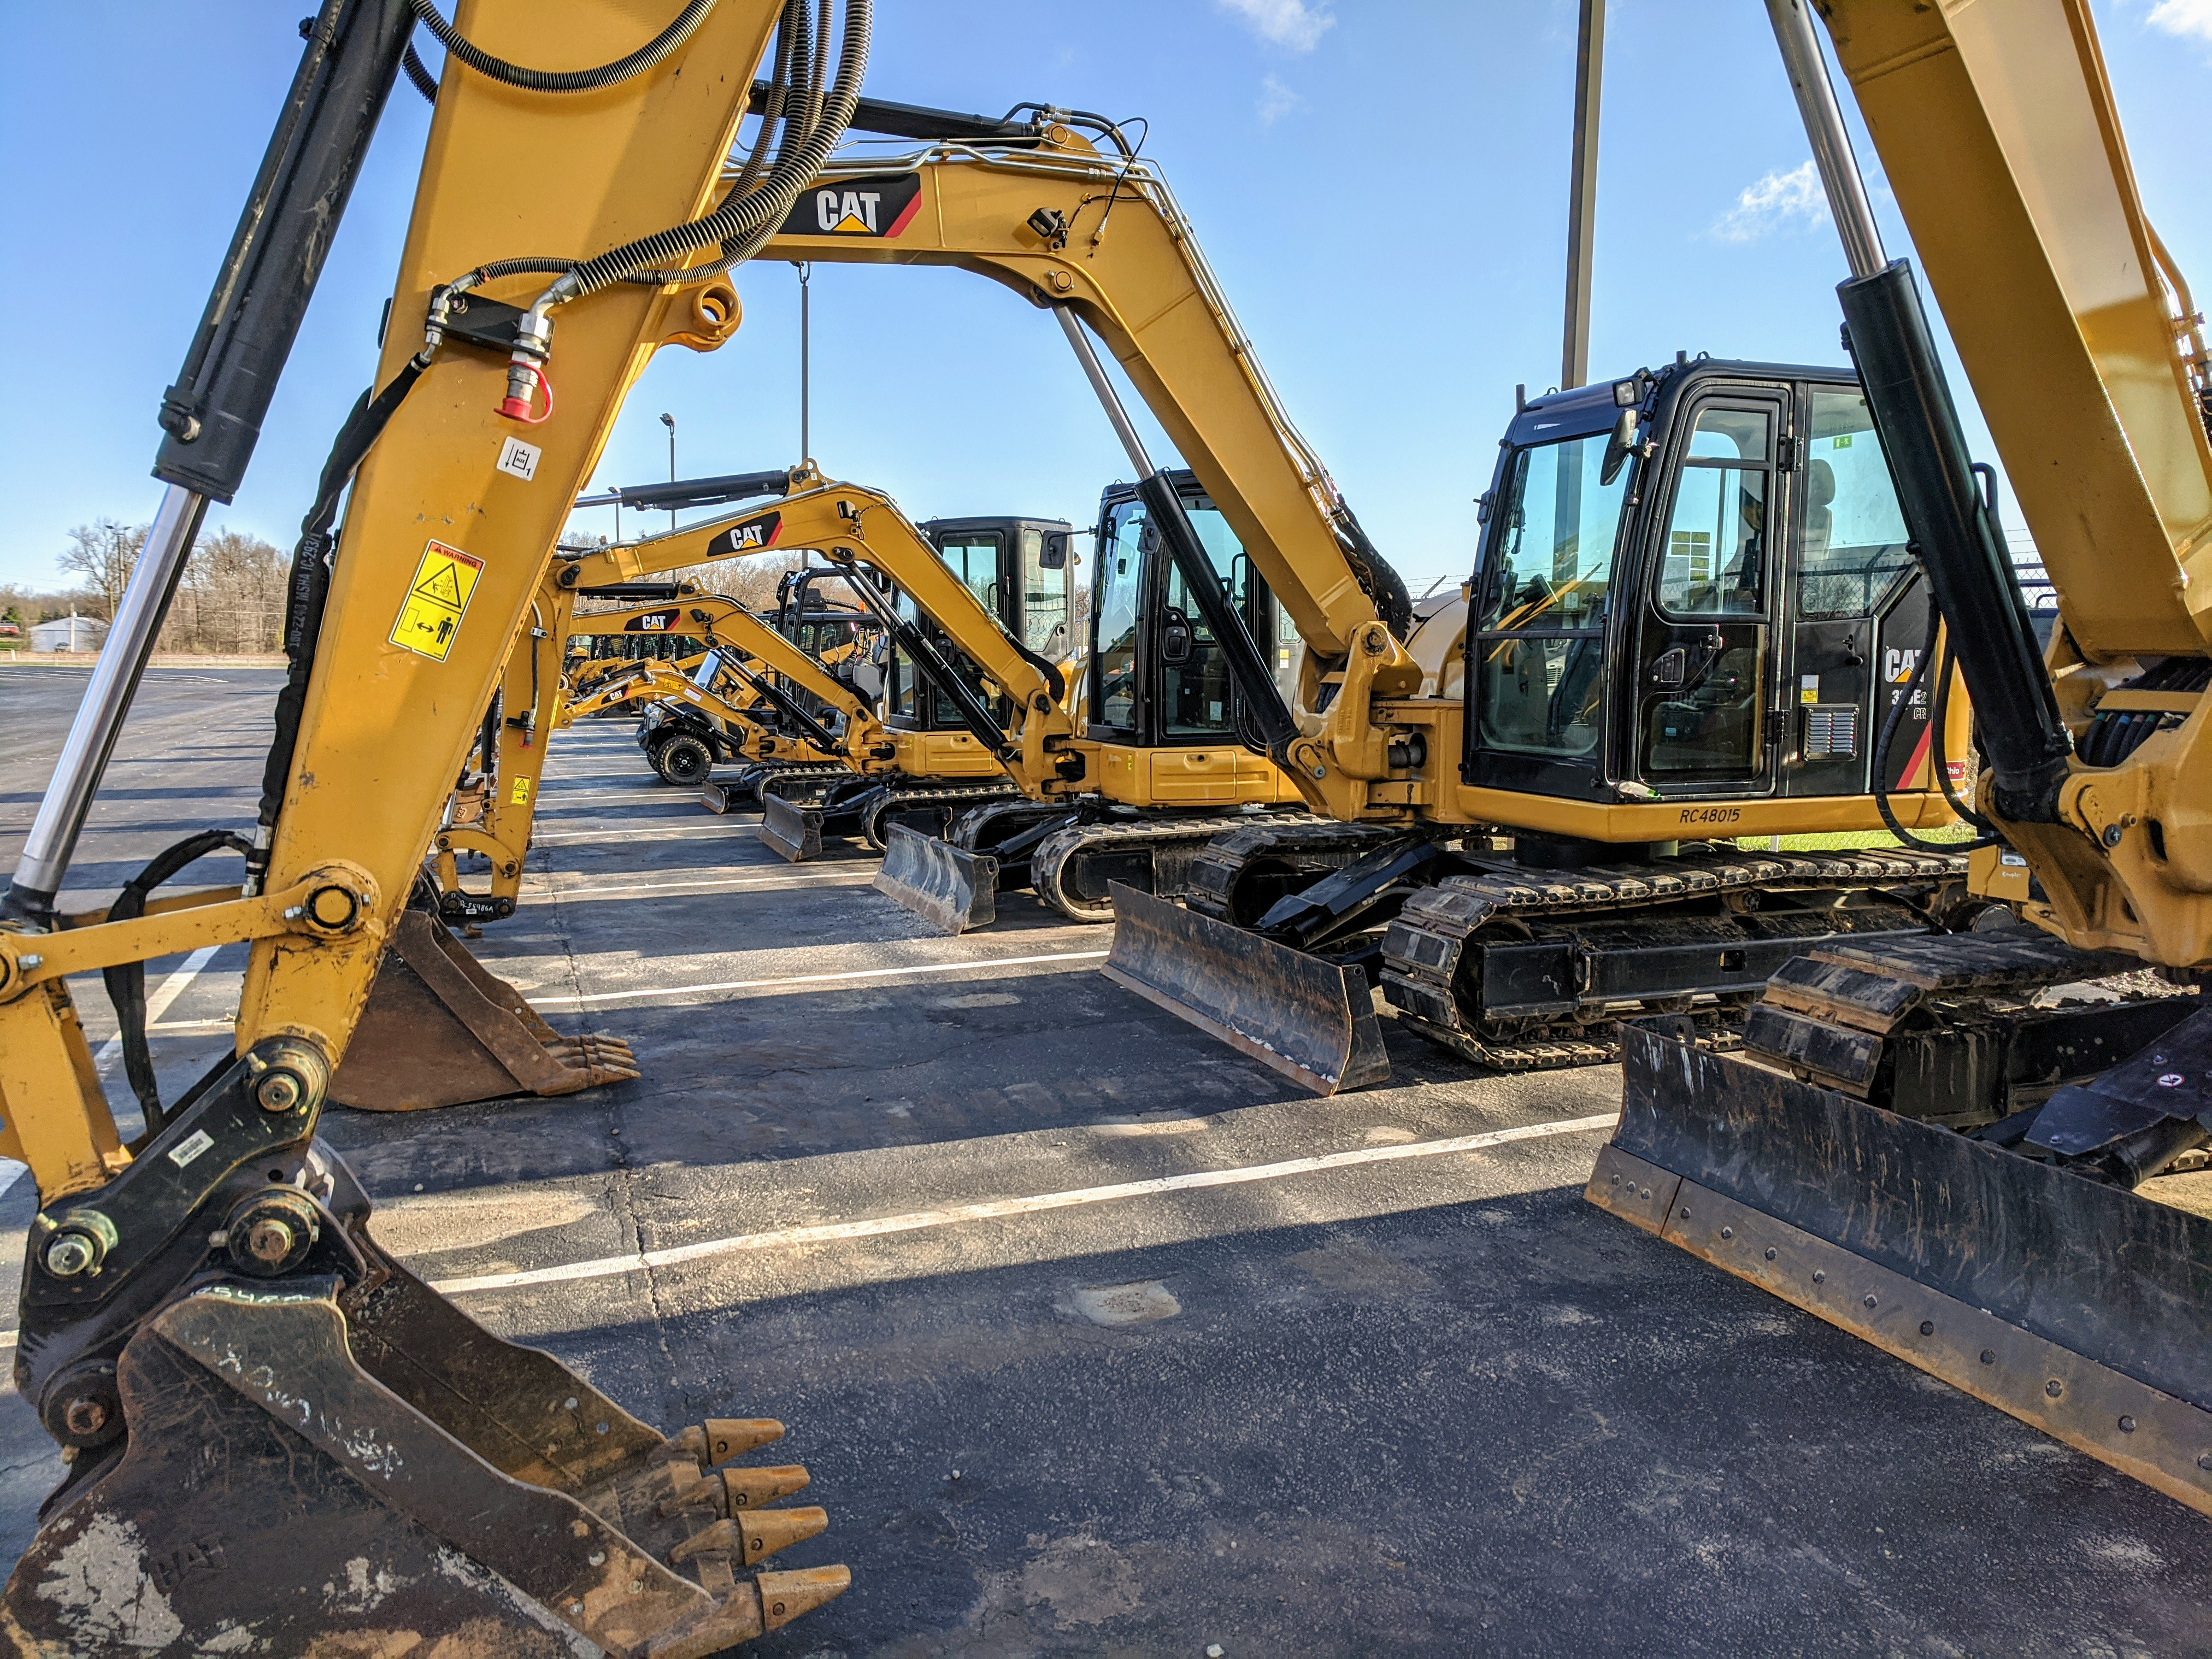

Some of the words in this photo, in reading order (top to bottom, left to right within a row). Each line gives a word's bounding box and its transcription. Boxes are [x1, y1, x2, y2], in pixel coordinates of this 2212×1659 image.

[816, 190, 880, 233] CAT
[526, 468, 531, 476] 1
[730, 525, 763, 550] CAT
[443, 549, 477, 567] WARNING
[295, 574, 311, 602] MSHA
[642, 615, 666, 631] CAT
[609, 690, 623, 701] CAT
[1914, 707, 1926, 720] CR
[1679, 808, 1741, 823] RC48015
